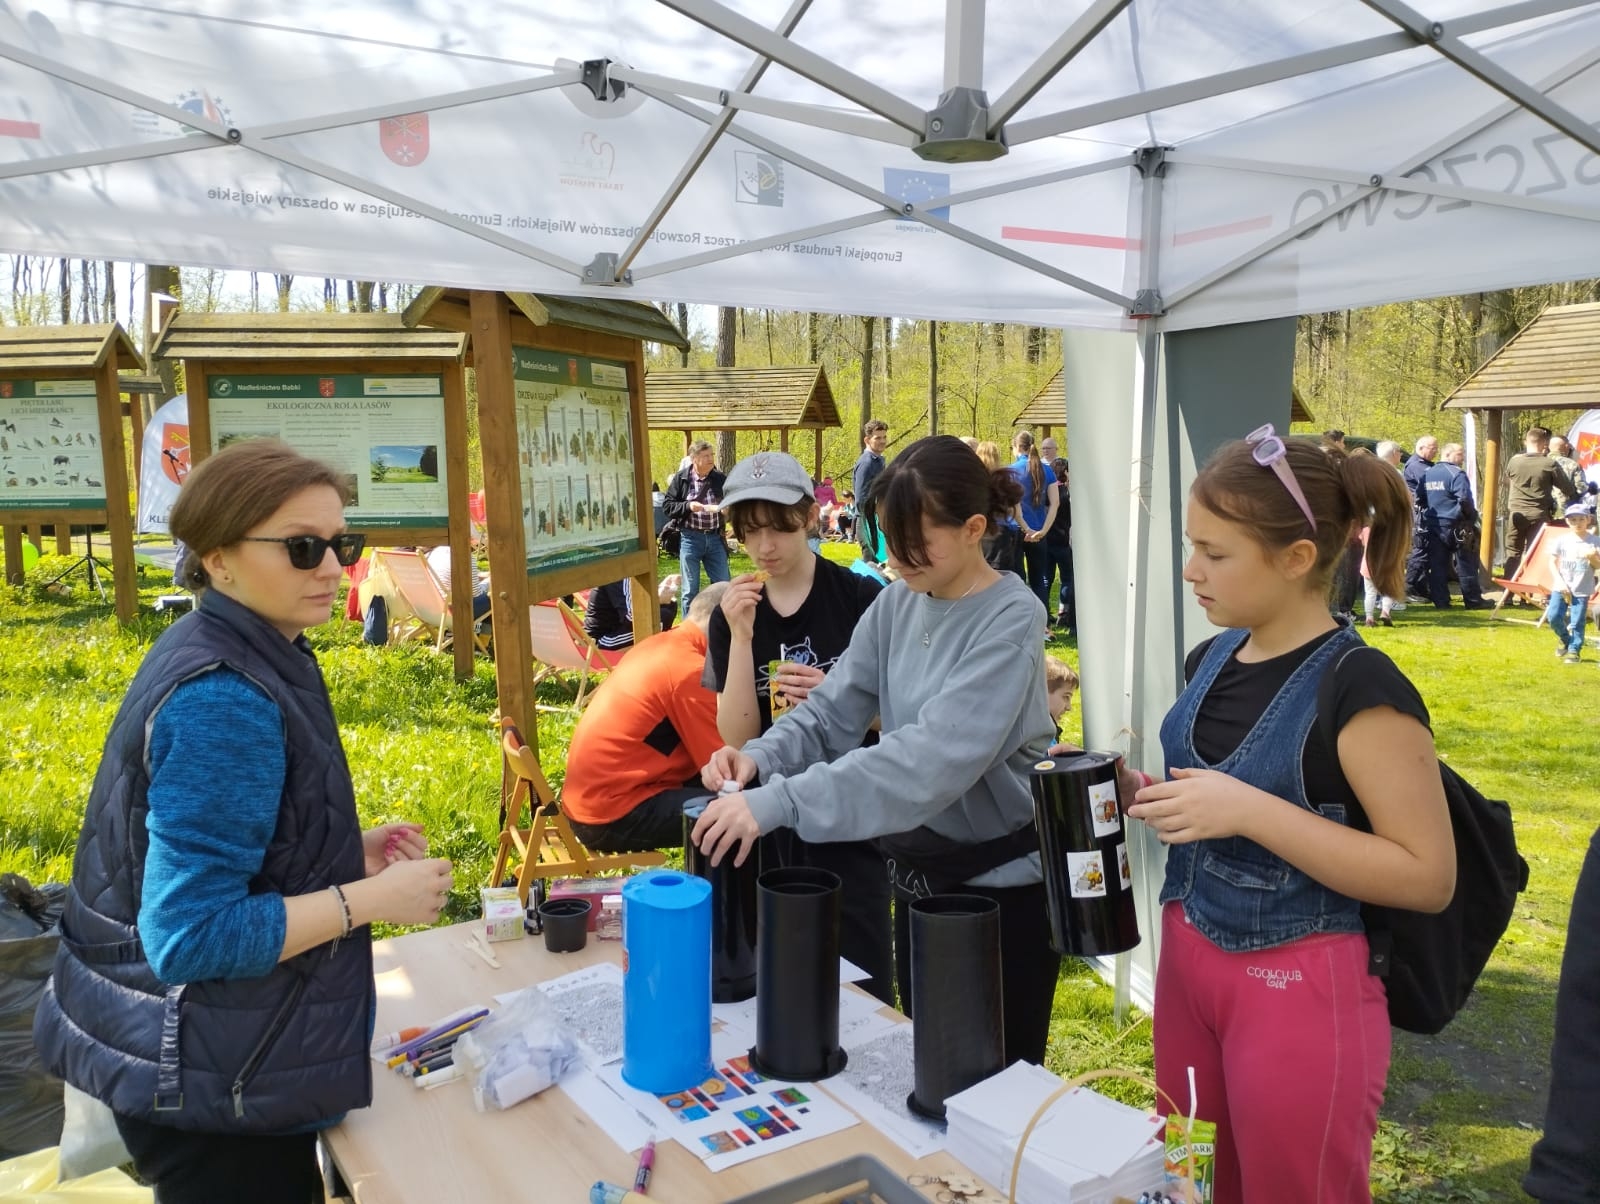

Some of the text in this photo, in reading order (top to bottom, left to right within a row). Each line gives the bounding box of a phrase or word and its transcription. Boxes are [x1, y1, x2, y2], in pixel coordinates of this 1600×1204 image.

[266, 400, 392, 410] EKOLOGICZNA ROLA LASÓW
[1246, 966, 1303, 981] COOLCLUB
[1169, 1144, 1213, 1161] TYMARK
